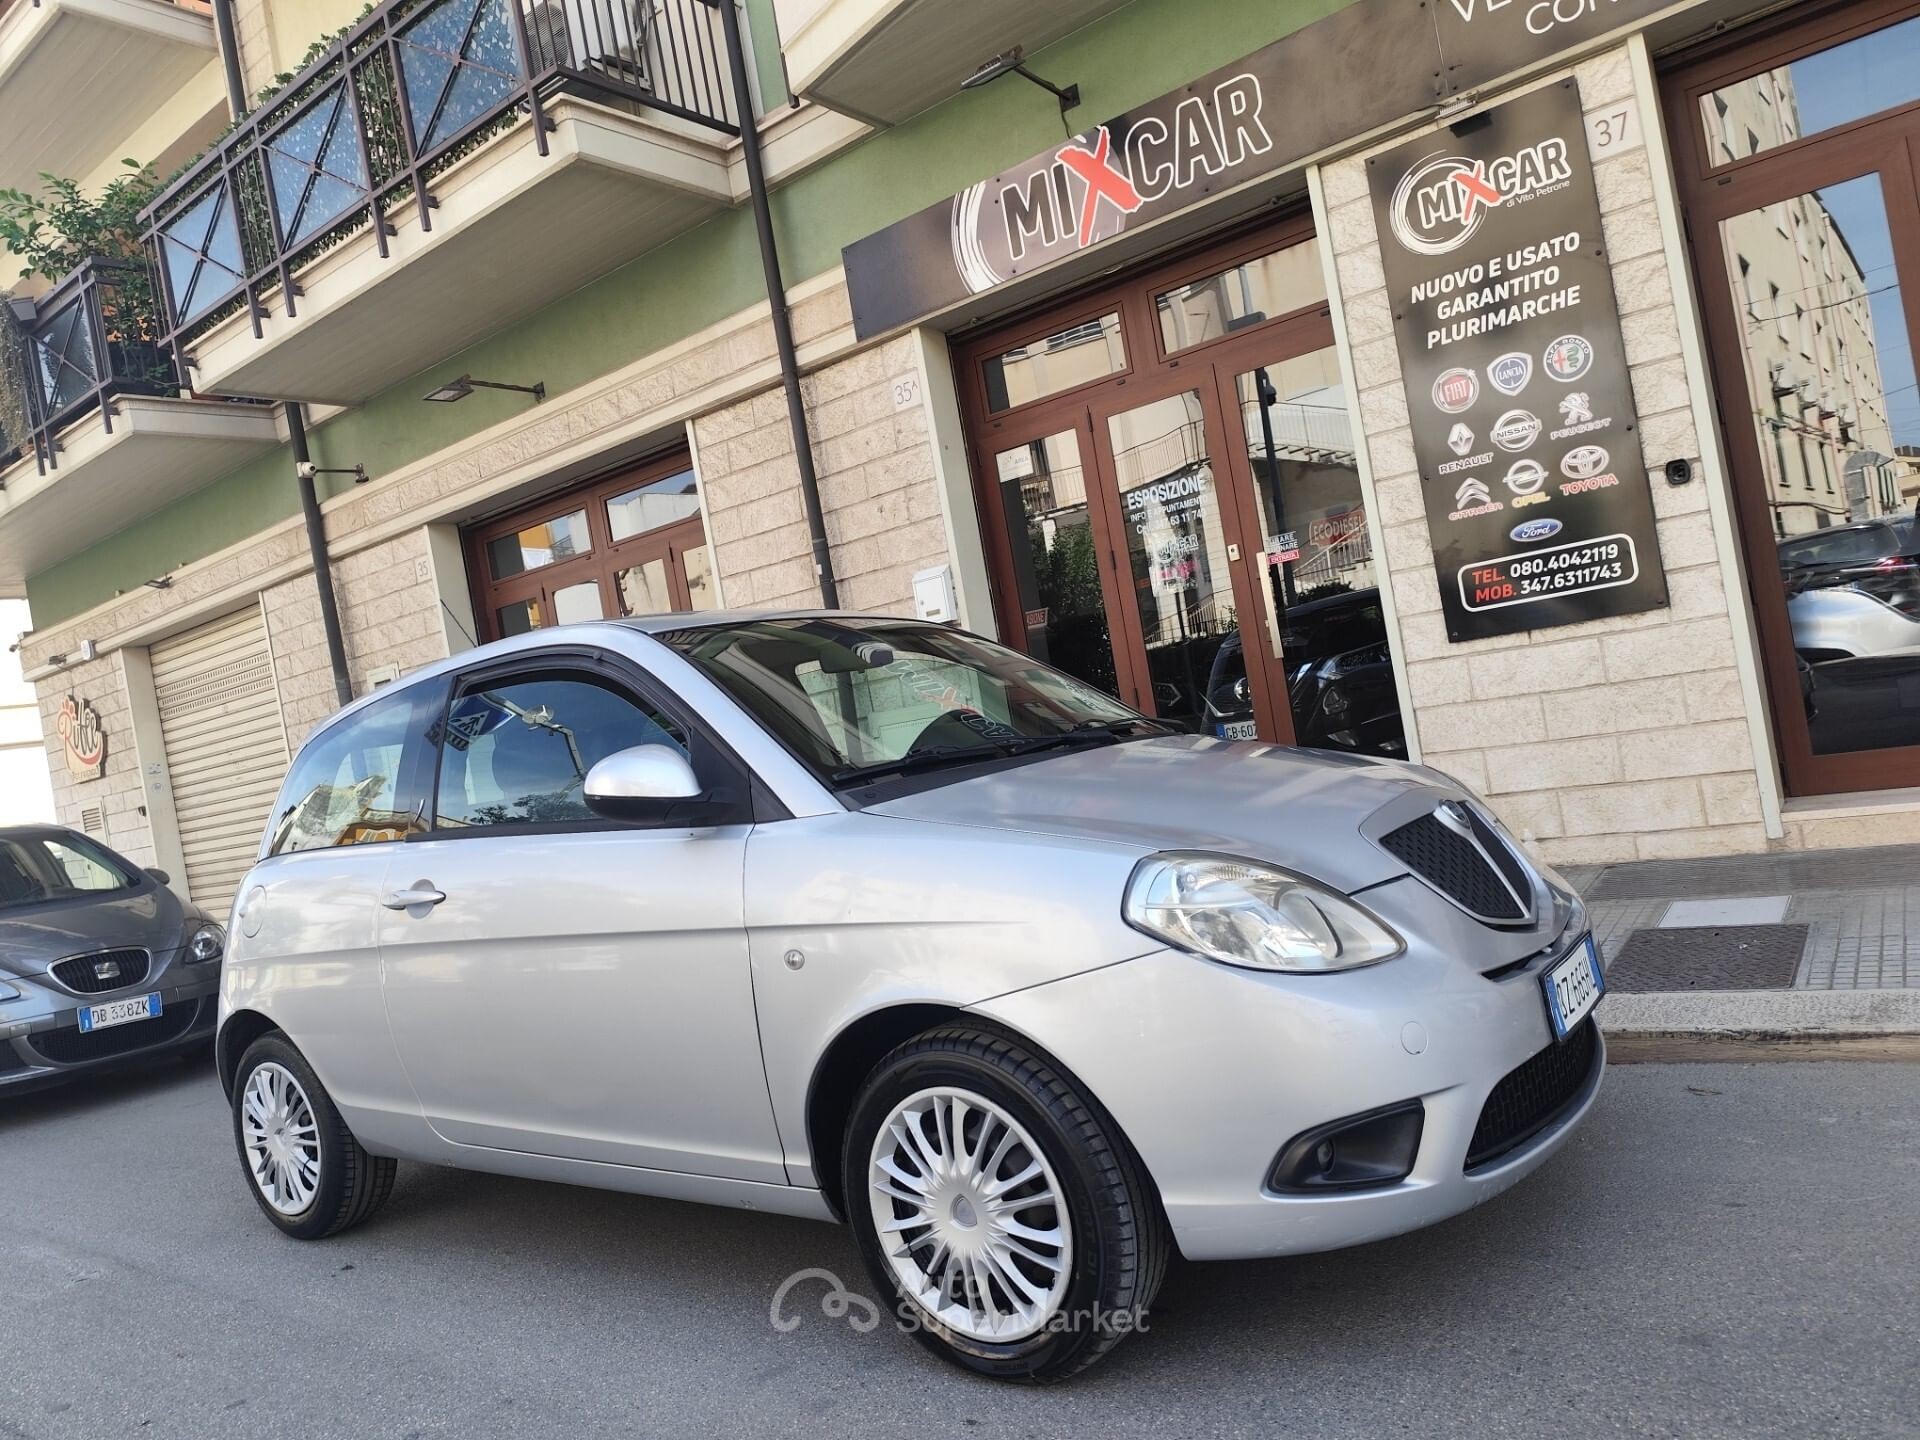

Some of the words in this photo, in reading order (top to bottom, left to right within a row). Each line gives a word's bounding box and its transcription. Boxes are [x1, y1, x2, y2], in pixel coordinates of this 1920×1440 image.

[1594, 111, 1628, 148] 37
[1001, 73, 1273, 260] MIXCAR
[1417, 137, 1572, 229] MIXCAR
[1506, 198, 1515, 208] di
[1515, 192, 1535, 205] Vito
[1536, 179, 1571, 198] Petrone
[1410, 264, 1484, 304] NUOVO
[1488, 257, 1502, 278] E
[1506, 231, 1580, 271] USATO
[1436, 265, 1560, 320] GARANTITO
[1427, 285, 1581, 349] PLURIMARCHE
[1499, 366, 1523, 381] LANCIA
[1444, 379, 1467, 403] FIAT
[1496, 422, 1536, 439] NISSAN
[1550, 418, 1612, 440] PEUGEOT
[1439, 452, 1494, 474] RENAULT
[1126, 473, 1209, 511] ESPOSIZIONE
[1560, 473, 1618, 496] TOYOTA
[1521, 523, 1551, 538] Ford
[1472, 569, 1505, 585] TEL.
[1510, 543, 1619, 578] 080.4042119
[1475, 583, 1517, 603] MOB.
[1520, 562, 1622, 595] 347.6311743
[92, 1009, 107, 1024] DB
